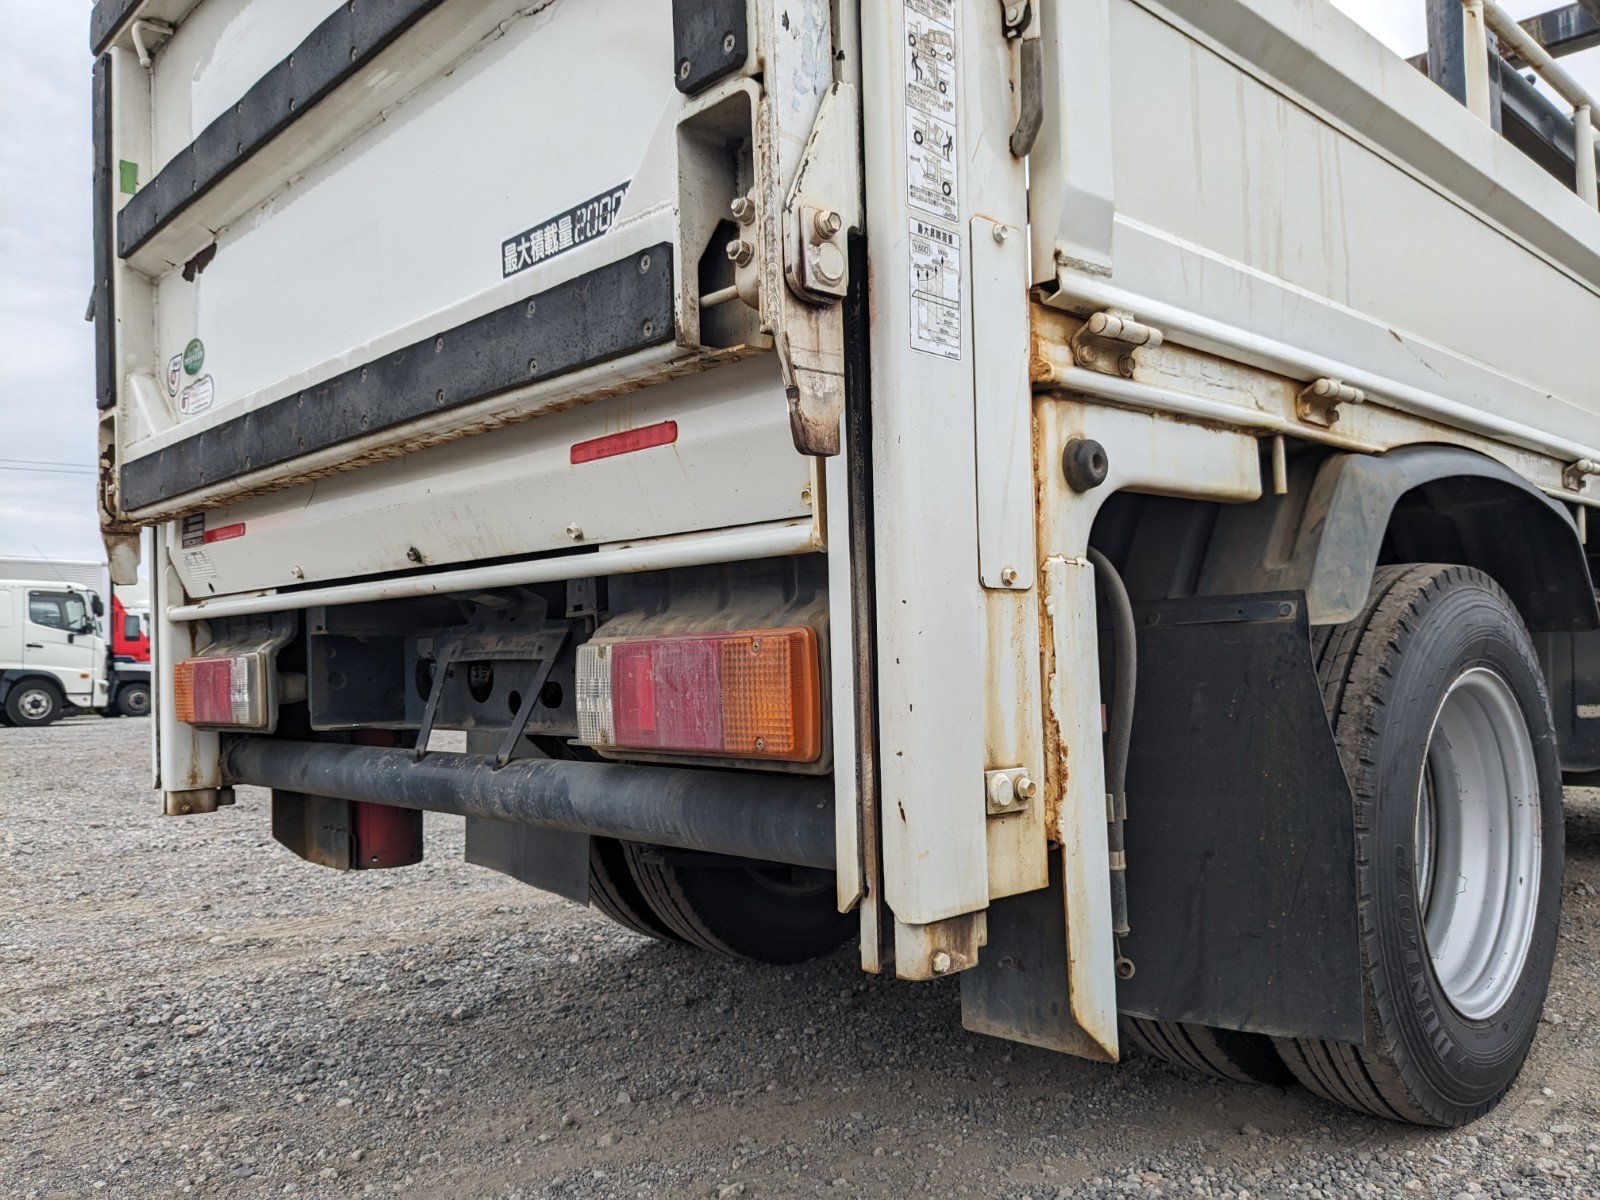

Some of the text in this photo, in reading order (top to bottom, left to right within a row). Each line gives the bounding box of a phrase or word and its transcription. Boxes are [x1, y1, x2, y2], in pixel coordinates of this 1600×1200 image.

[504, 215, 574, 274] 最大積載量
[1396, 844, 1454, 1063] DUNLOP
